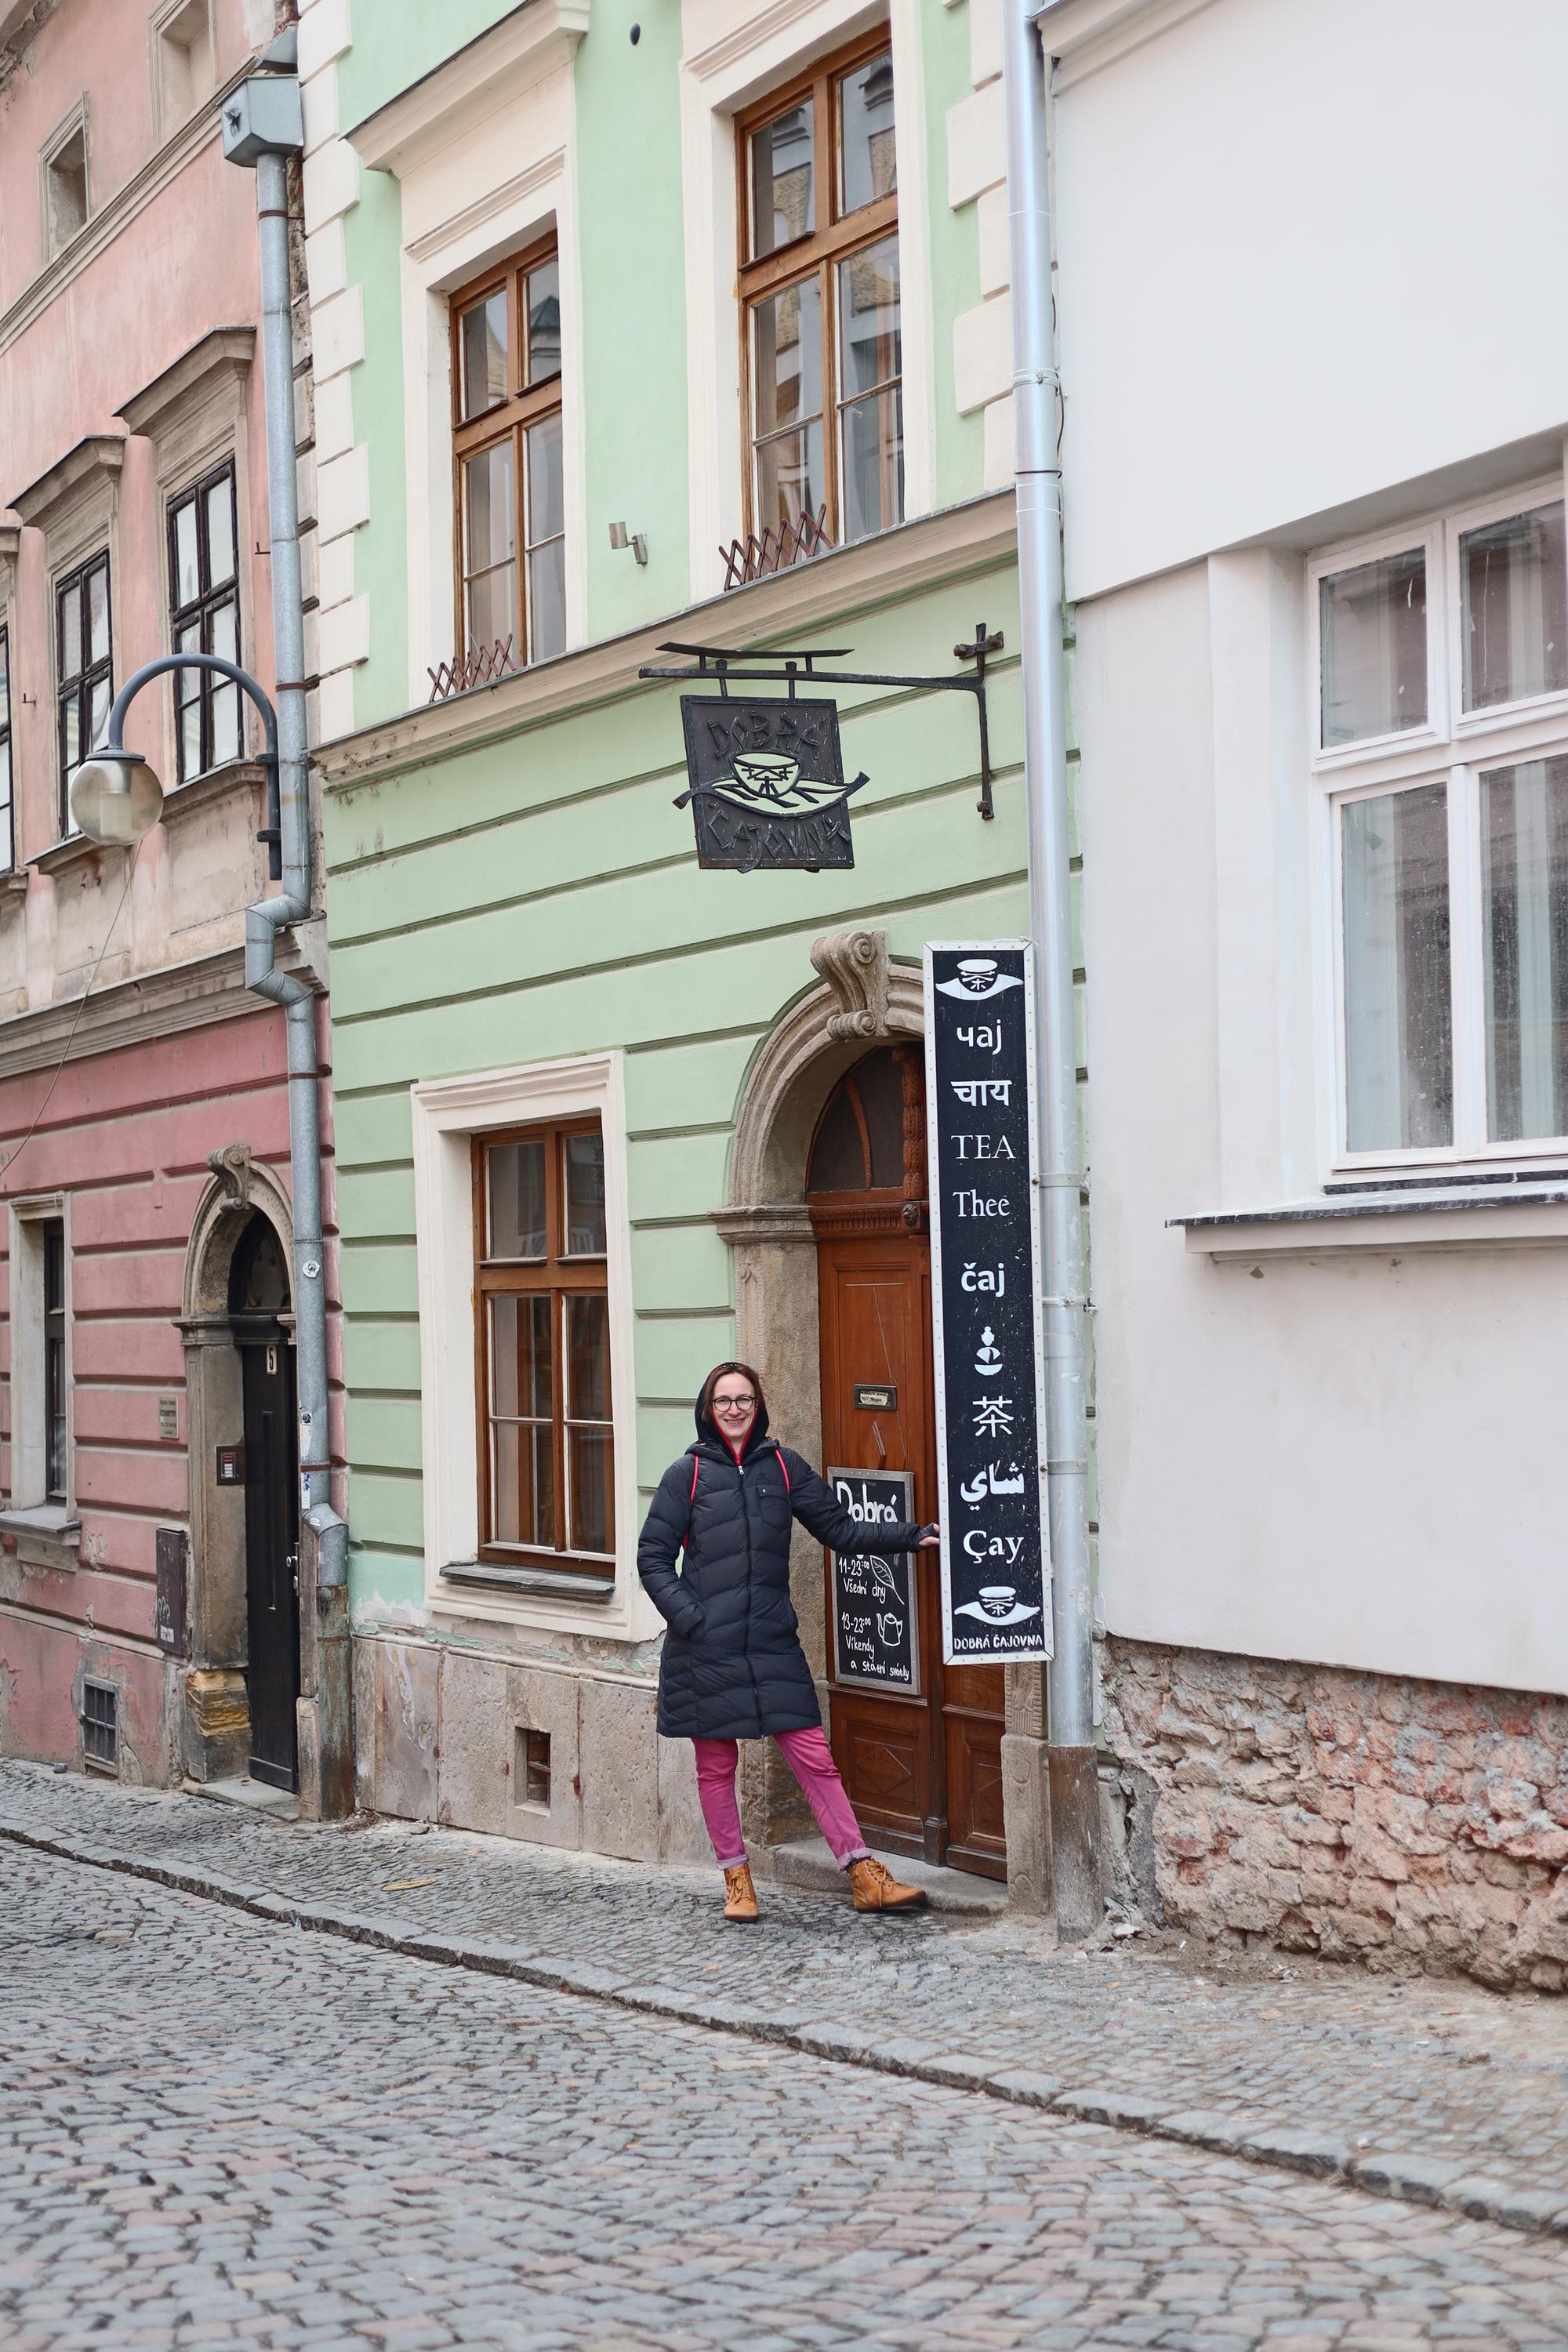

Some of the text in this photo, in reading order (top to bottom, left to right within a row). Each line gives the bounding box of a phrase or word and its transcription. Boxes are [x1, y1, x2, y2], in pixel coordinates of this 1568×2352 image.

[950, 1080, 1013, 1107] चाय
[950, 1134, 1017, 1160] TEA
[952, 1189, 1011, 1217] Thee
[960, 1261, 1005, 1298] čaj
[269, 1347, 274, 1371] 5
[972, 1396, 1014, 1438] 茶
[836, 1481, 898, 1523] Dobrá
[963, 1530, 1025, 1564] Çay
[843, 1577, 886, 1604] Všední dny
[845, 1635, 875, 1660] Víkendy
[953, 1634, 1043, 1650] DOBRÁ ČAJOVNA
[851, 1660, 858, 1669] a
[889, 1662, 909, 1681] svátky
